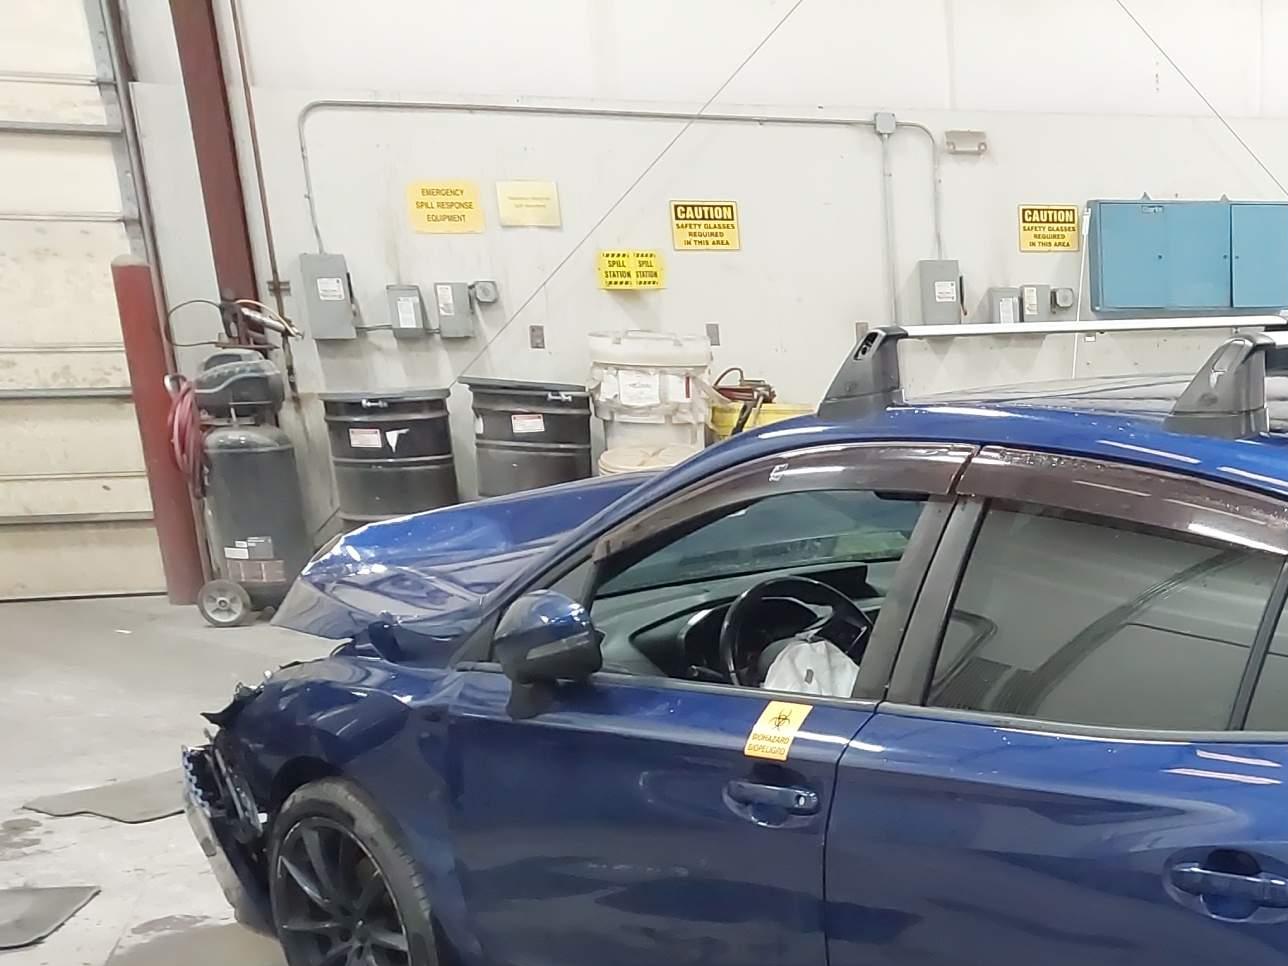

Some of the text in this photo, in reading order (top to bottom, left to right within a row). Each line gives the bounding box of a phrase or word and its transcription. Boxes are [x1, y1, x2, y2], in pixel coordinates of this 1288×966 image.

[421, 188, 464, 197] EMERGENCY
[415, 201, 474, 210] SPILL RESPONSE
[676, 206, 733, 220] CAUTION
[1024, 210, 1074, 223] CAUTION
[426, 214, 467, 223] EQUIPMENT
[607, 260, 627, 268] SPILL
[637, 260, 654, 268] SPILL
[604, 271, 632, 279] STATION
[635, 271, 658, 279] STATION
